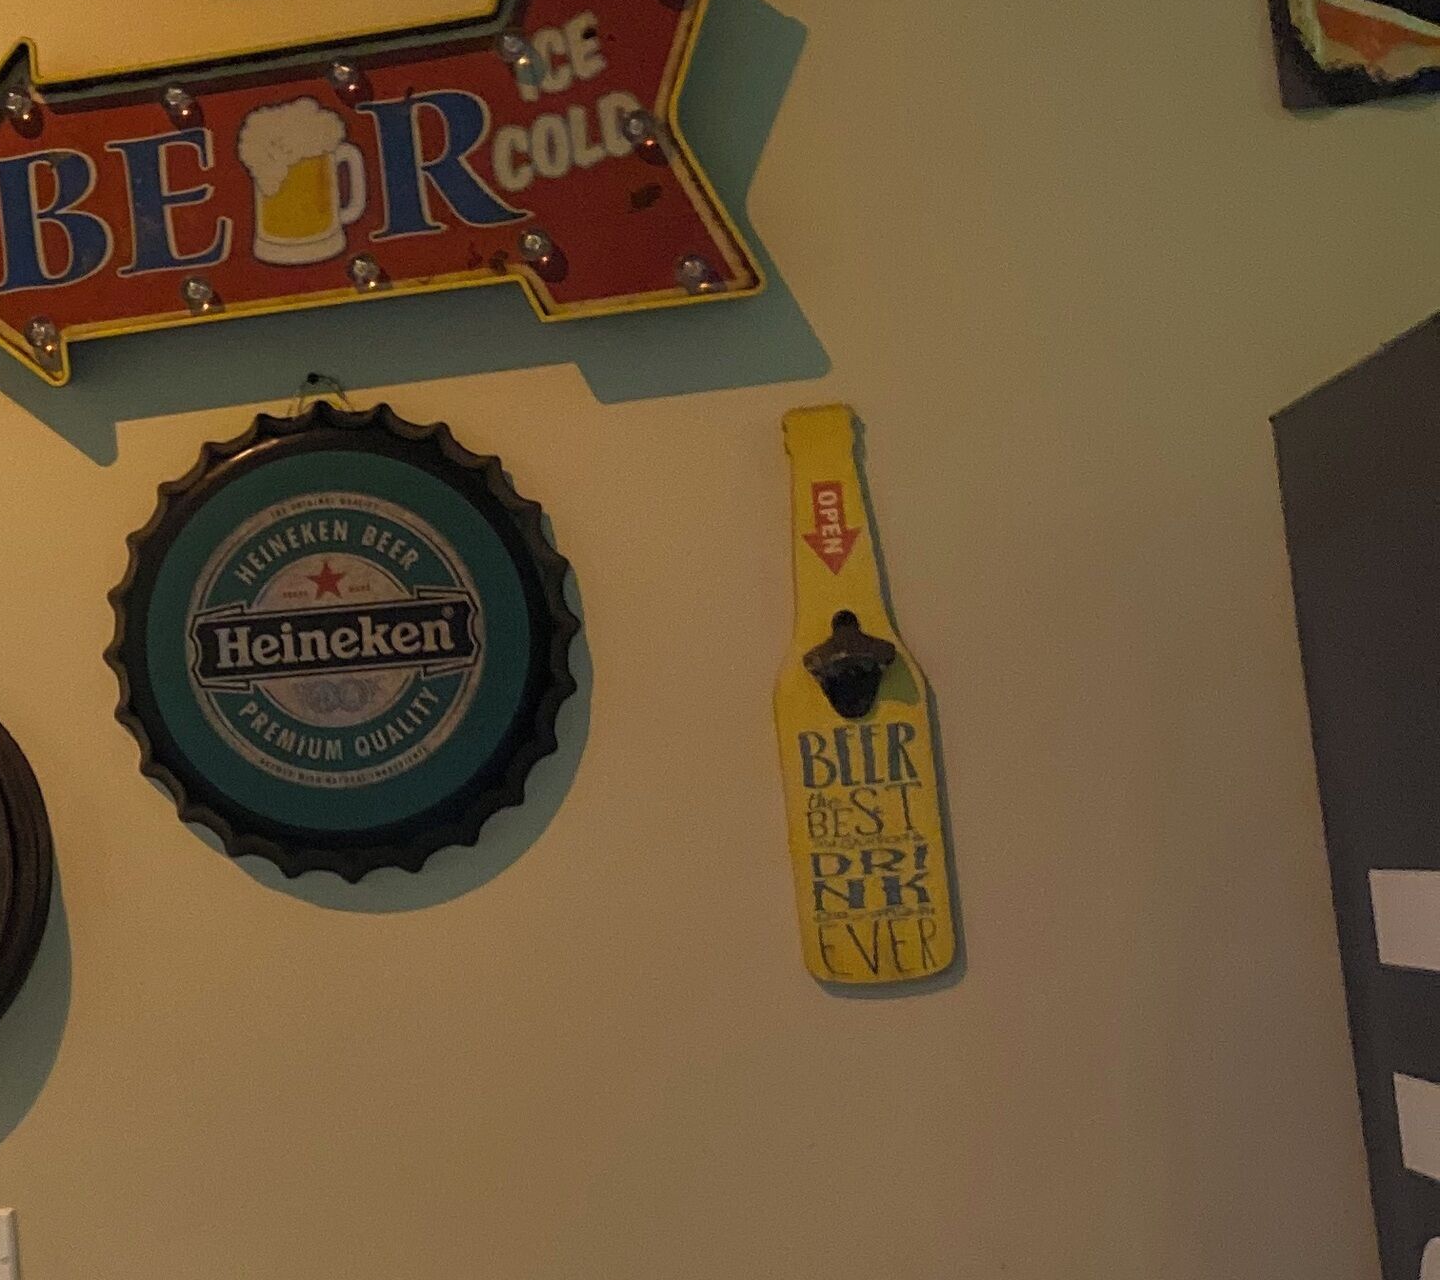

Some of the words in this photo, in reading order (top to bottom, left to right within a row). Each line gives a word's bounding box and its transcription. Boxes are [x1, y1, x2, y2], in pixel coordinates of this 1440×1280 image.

[234, 519, 348, 586] HEINEKEN
[360, 525, 420, 571] BEER
[817, 490, 845, 555] OPEN
[215, 616, 455, 670] Heineken
[237, 700, 344, 761] PREMIUM
[353, 686, 439, 758] QUALITY
[798, 722, 918, 790] BEER
[817, 917, 938, 977] EVER
